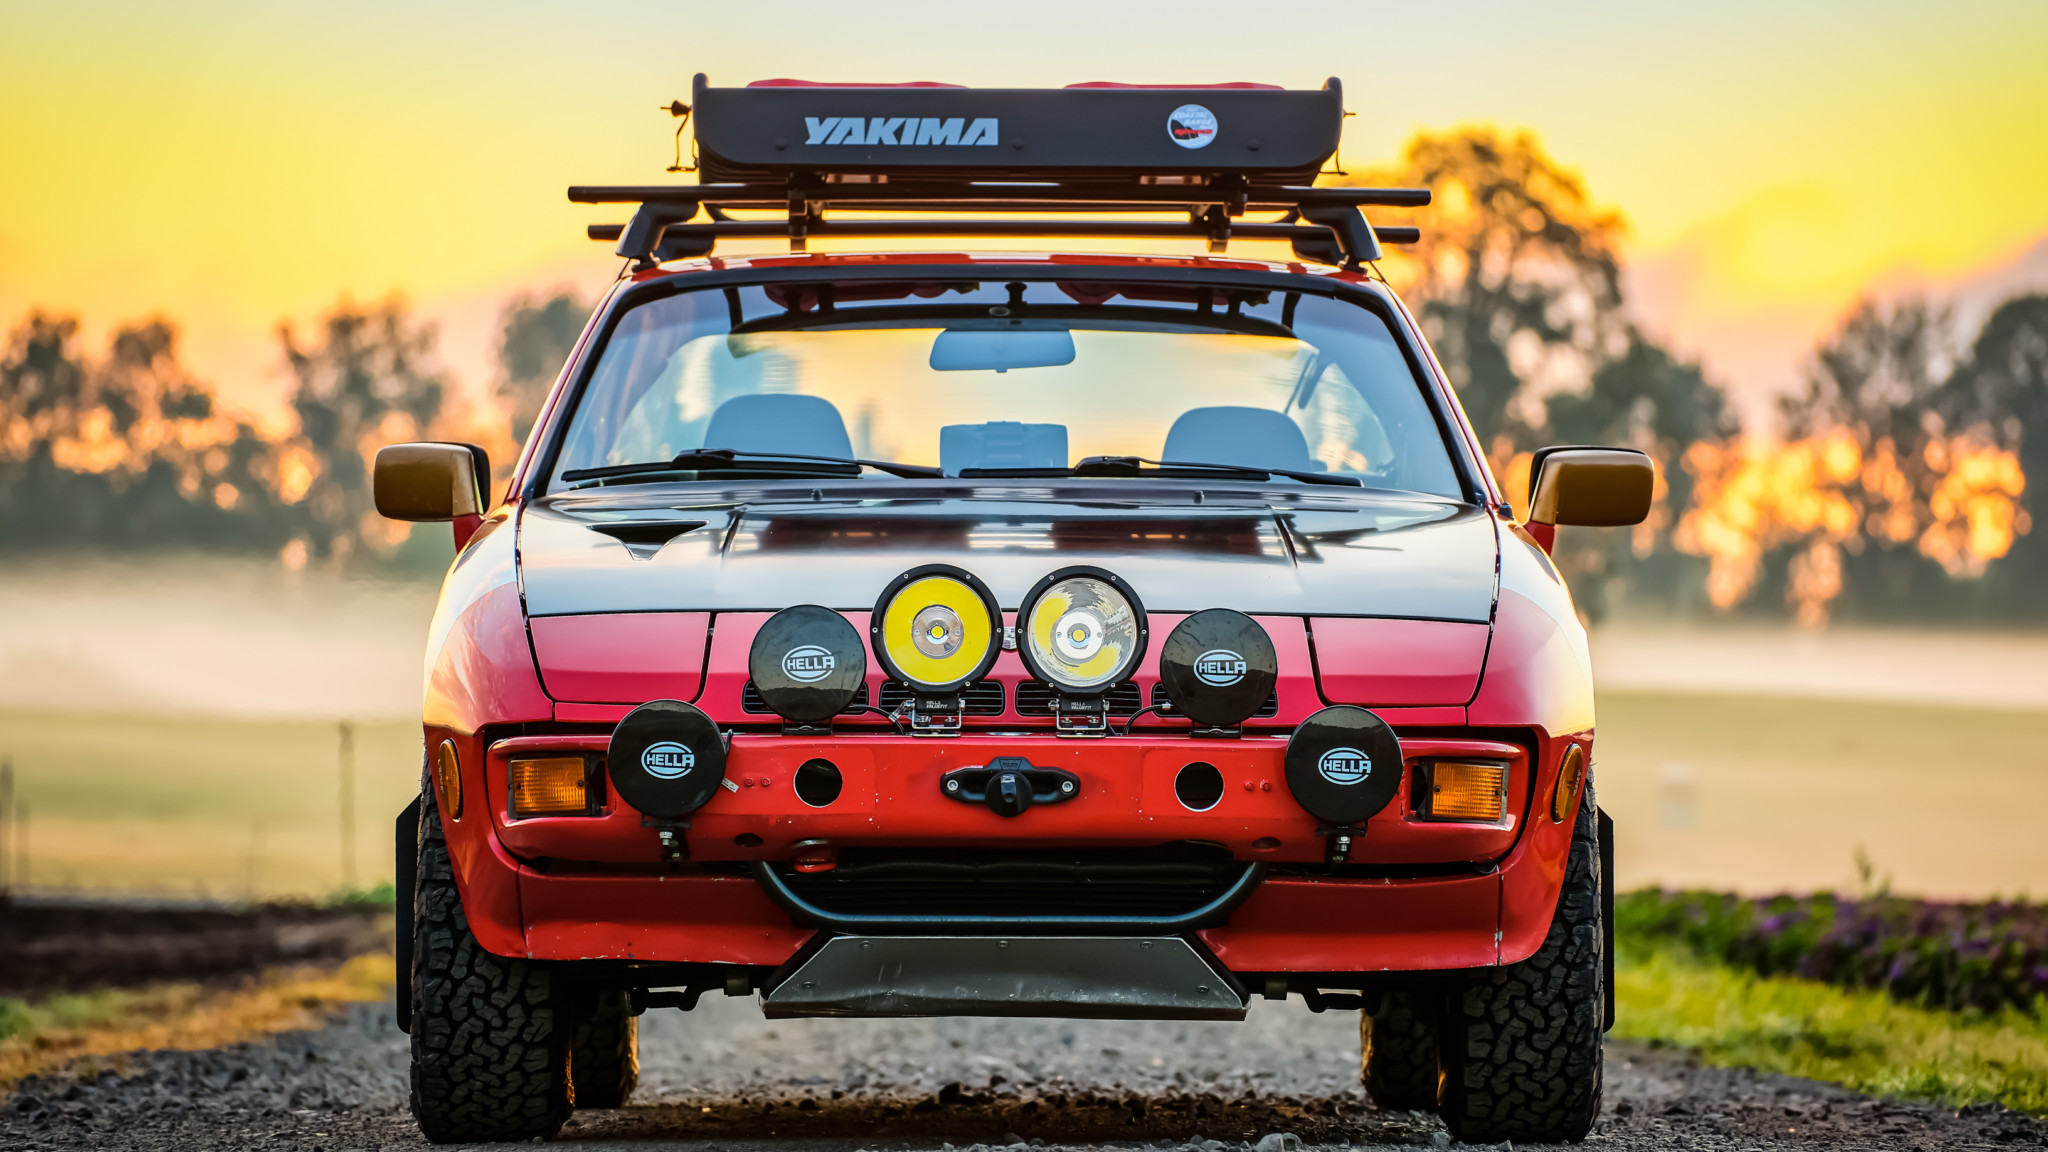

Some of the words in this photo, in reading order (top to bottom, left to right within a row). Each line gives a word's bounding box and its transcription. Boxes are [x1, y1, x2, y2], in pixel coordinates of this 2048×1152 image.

[804, 117, 999, 146] YAKIMA
[787, 656, 835, 670] HELLA
[1198, 661, 1247, 674] HELLA
[646, 753, 695, 767] HELLA
[1323, 759, 1372, 774] HELLA
